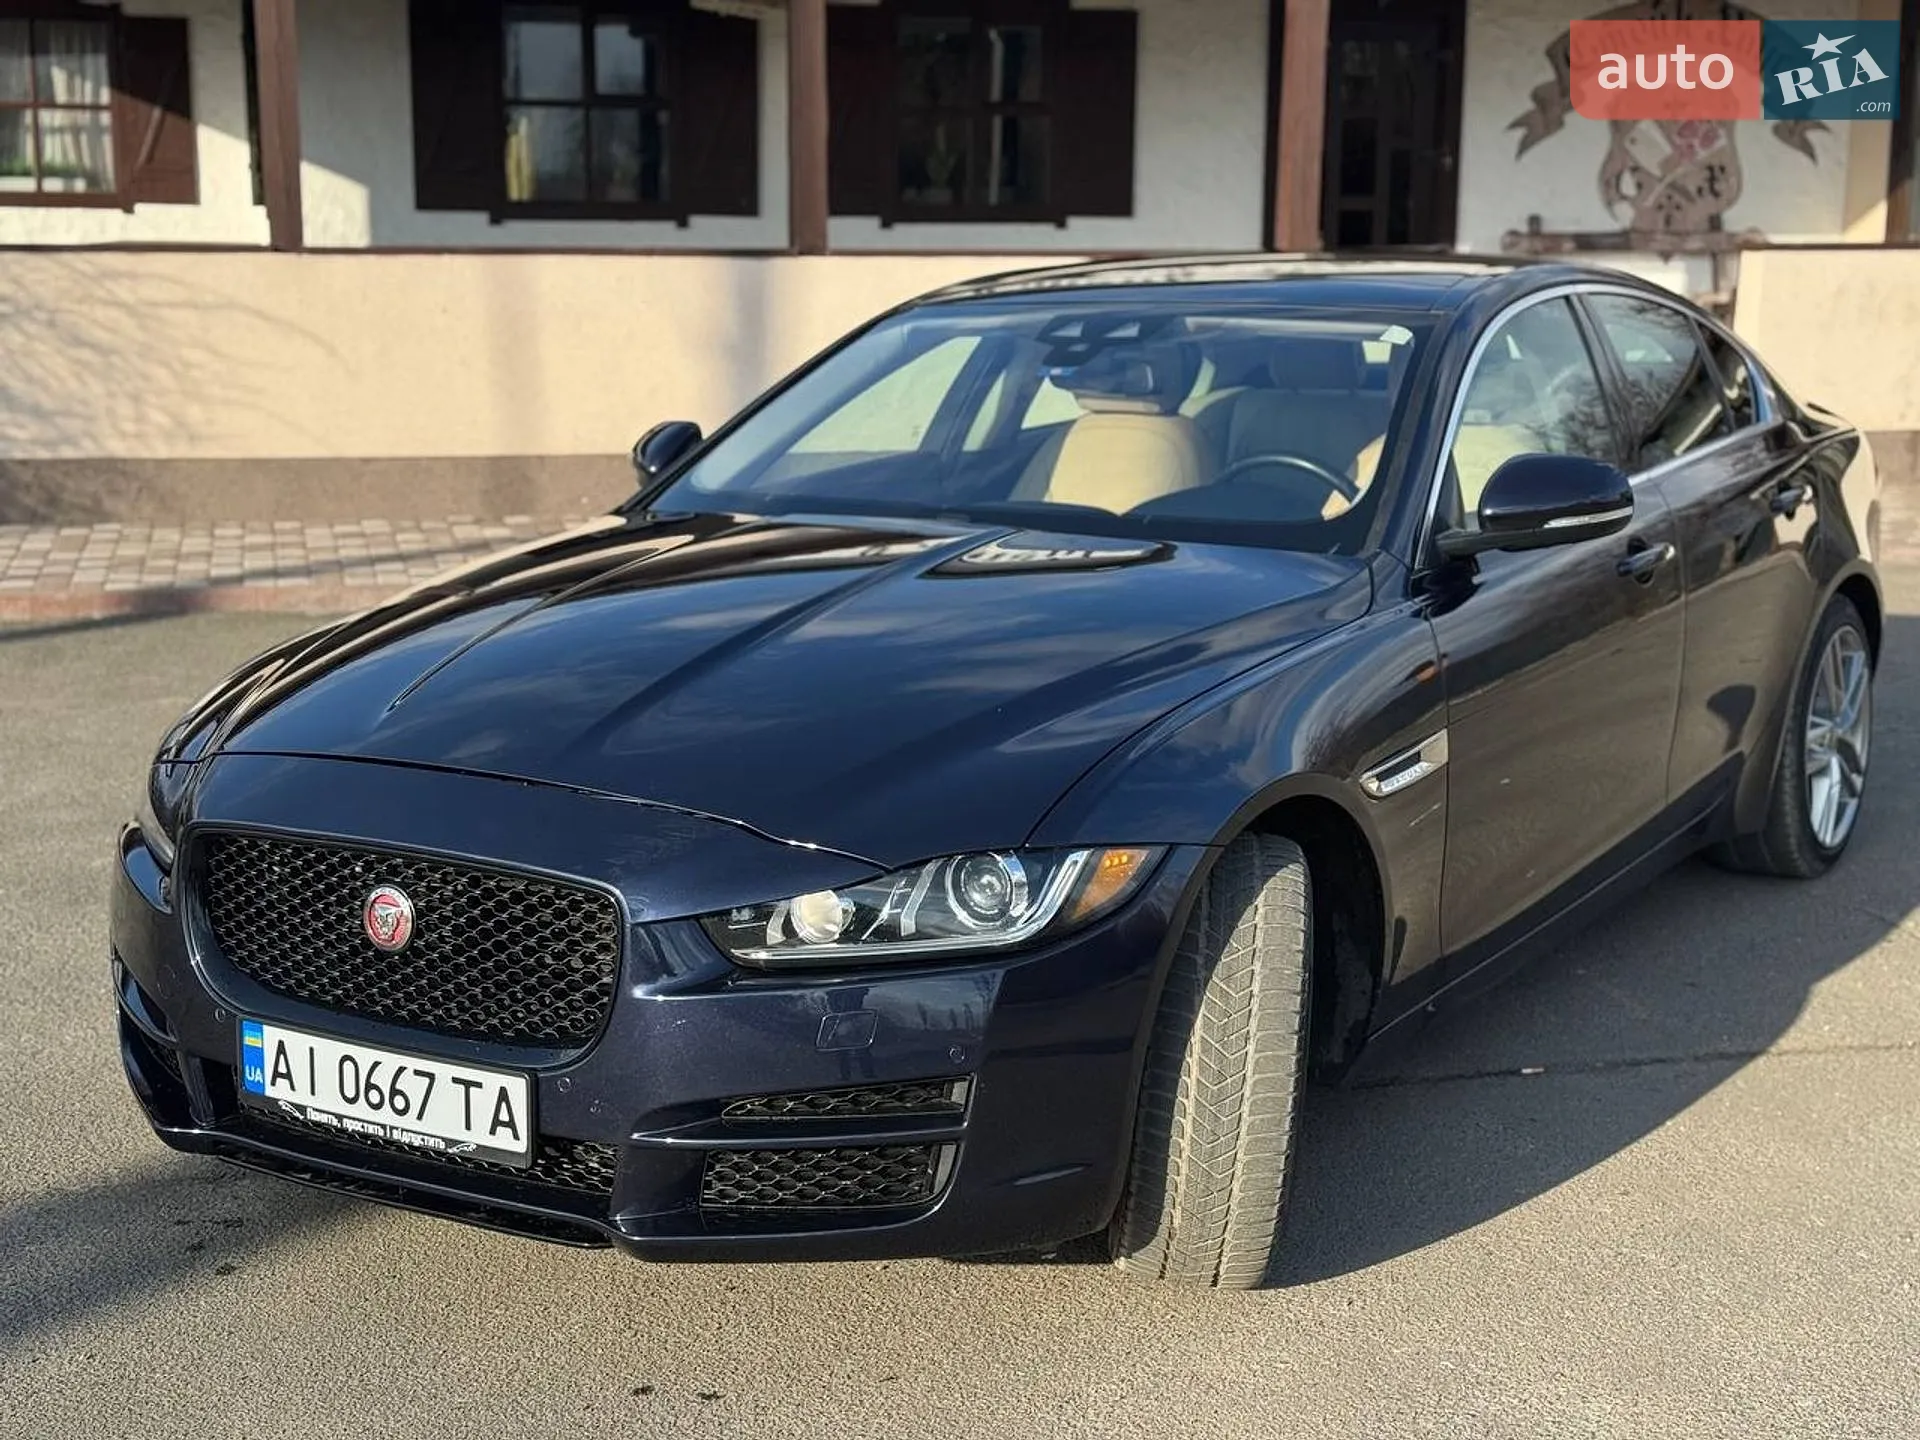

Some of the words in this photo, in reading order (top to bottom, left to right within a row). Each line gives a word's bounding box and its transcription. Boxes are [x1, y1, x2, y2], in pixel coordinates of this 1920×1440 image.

[245, 1066, 263, 1083] UA
[269, 1039, 316, 1097] AI
[338, 1054, 436, 1121] 0667
[451, 1076, 521, 1141] TA
